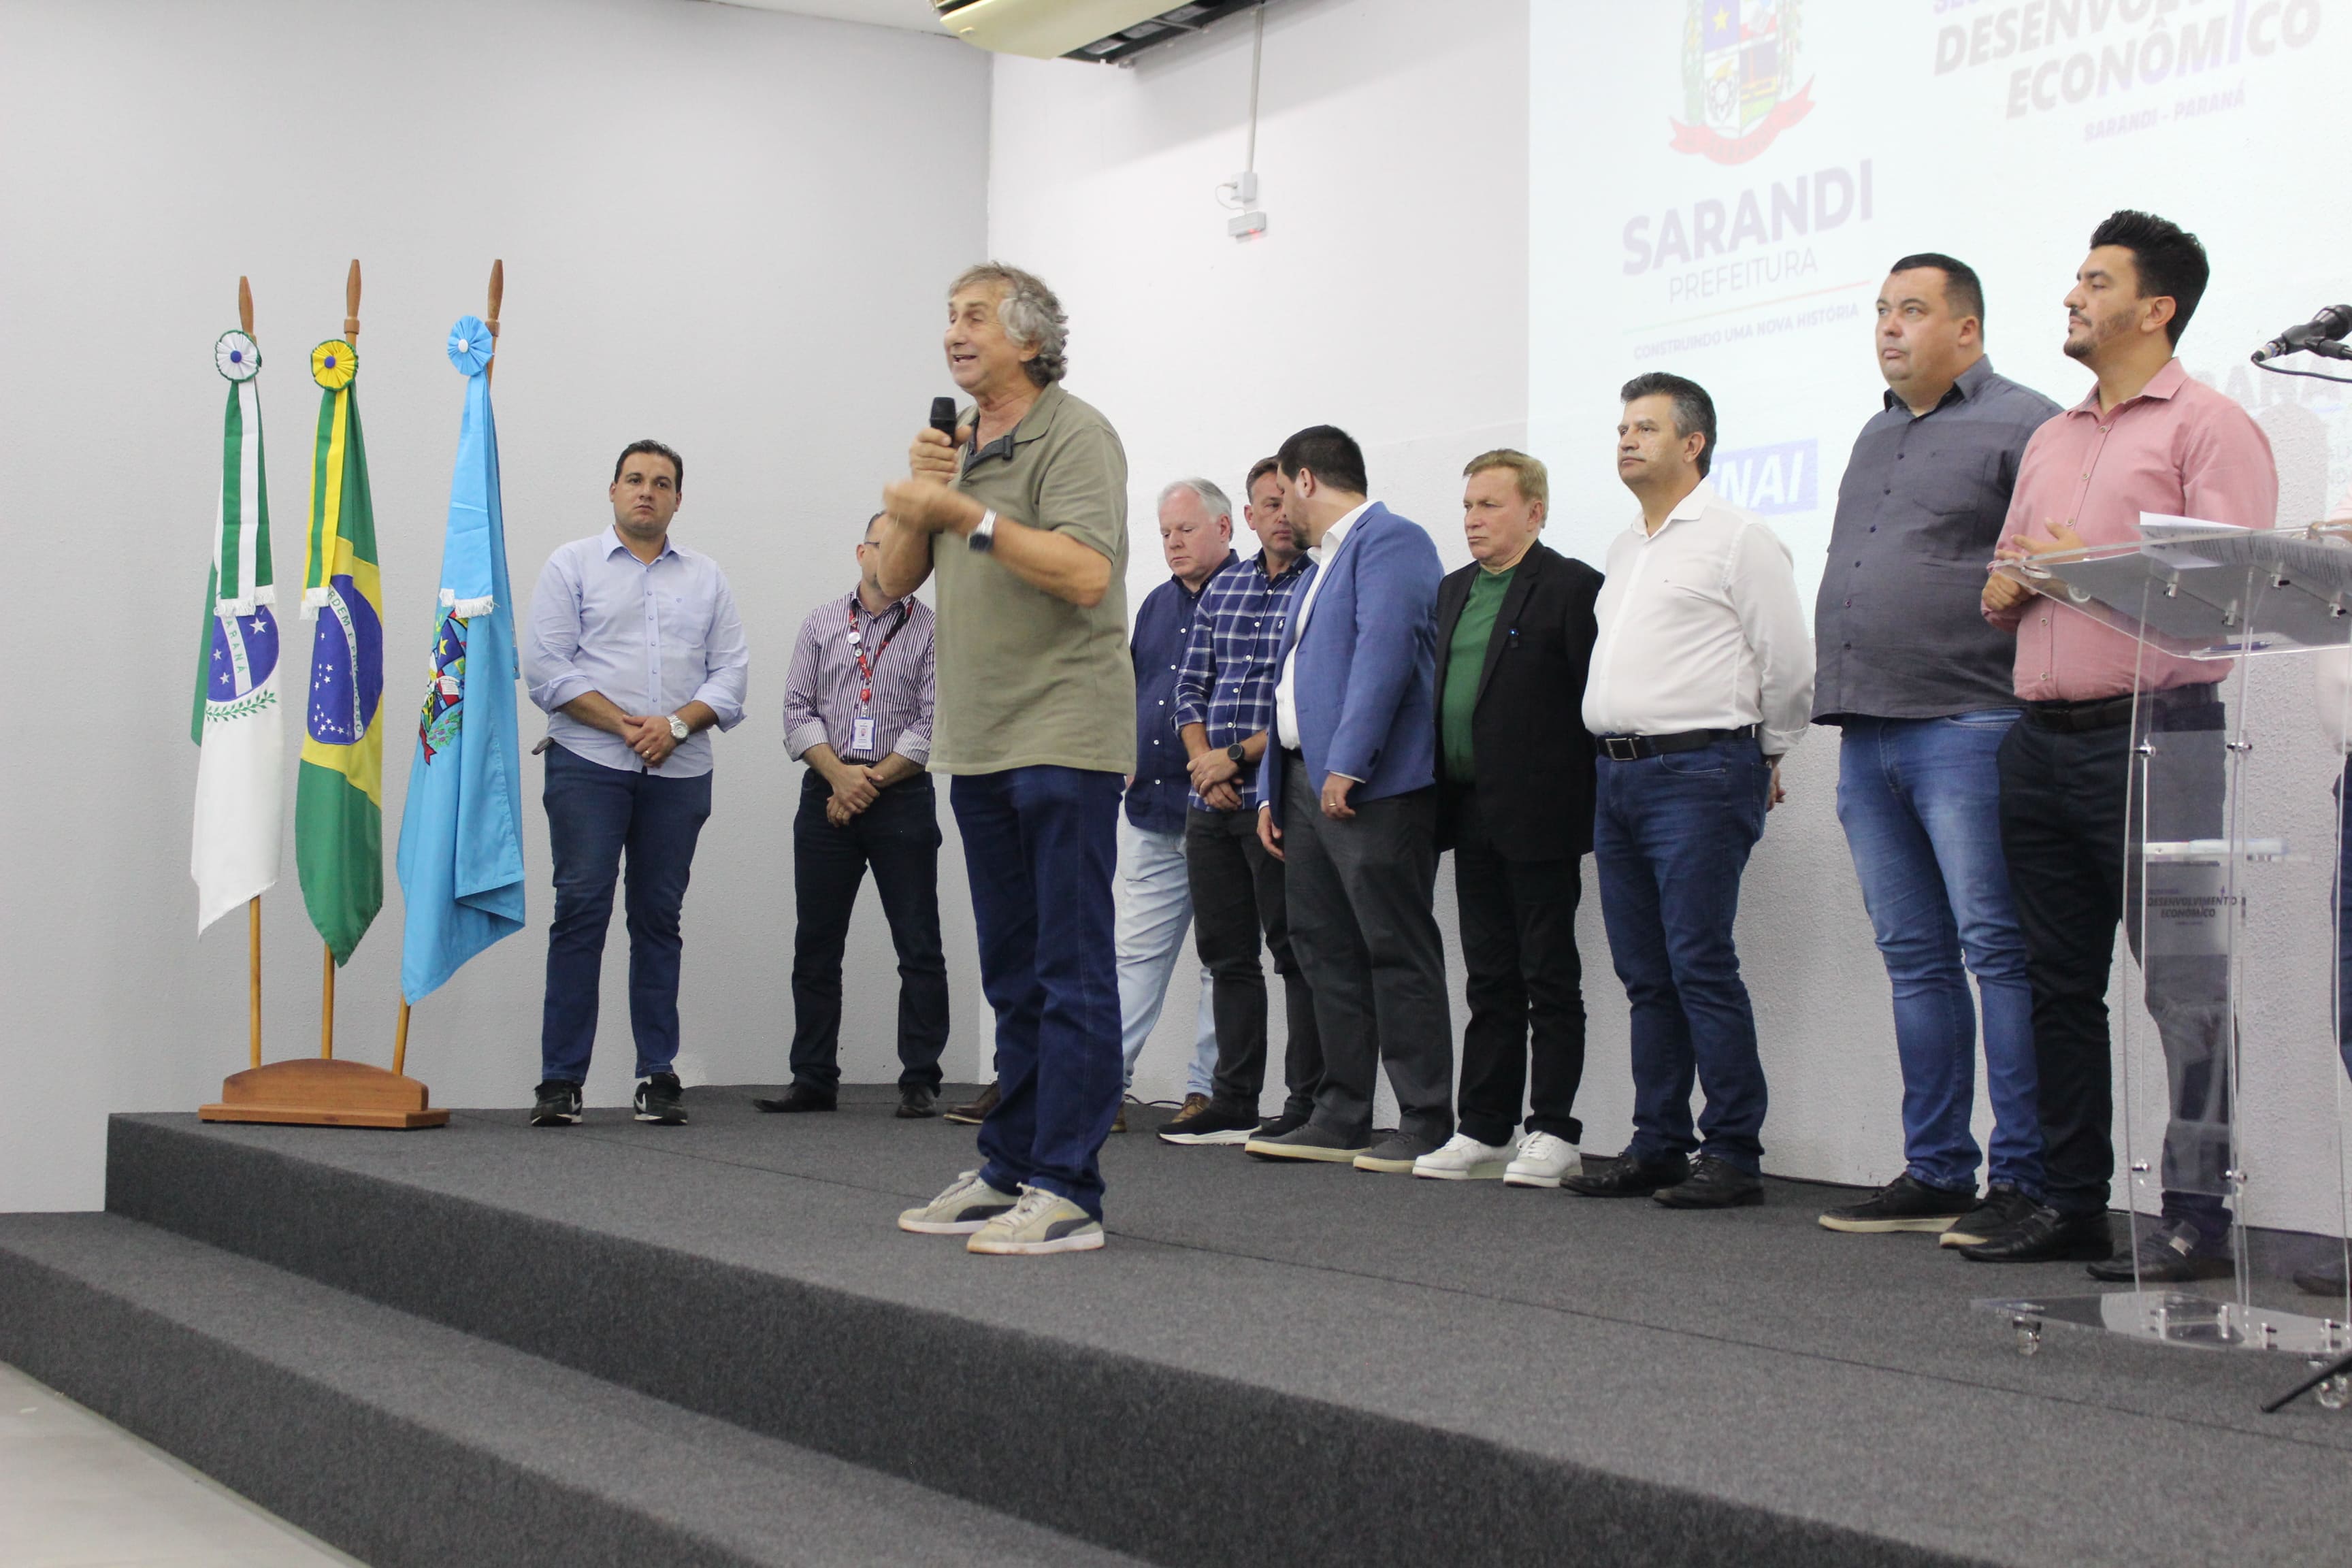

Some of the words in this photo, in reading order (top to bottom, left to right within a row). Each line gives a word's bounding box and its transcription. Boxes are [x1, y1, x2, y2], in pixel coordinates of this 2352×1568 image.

[1933, 0, 2205, 76] DESENVO
[2006, 0, 2321, 119] ECONÔMICO
[2083, 107, 2158, 142] SARANDI
[2173, 78, 2246, 122] PARANÁ
[1622, 158, 1873, 277] SARANDI
[1669, 247, 1818, 304] PREFEITURA
[1634, 331, 1721, 359] CONSTRUINDO
[1725, 323, 1753, 342] UMA
[1757, 315, 1793, 338] NOVA
[1797, 302, 1859, 329] HISTÓRIA
[327, 591, 350, 626] RDEM
[2147, 896, 2237, 906] DESENVOLVIMENTO
